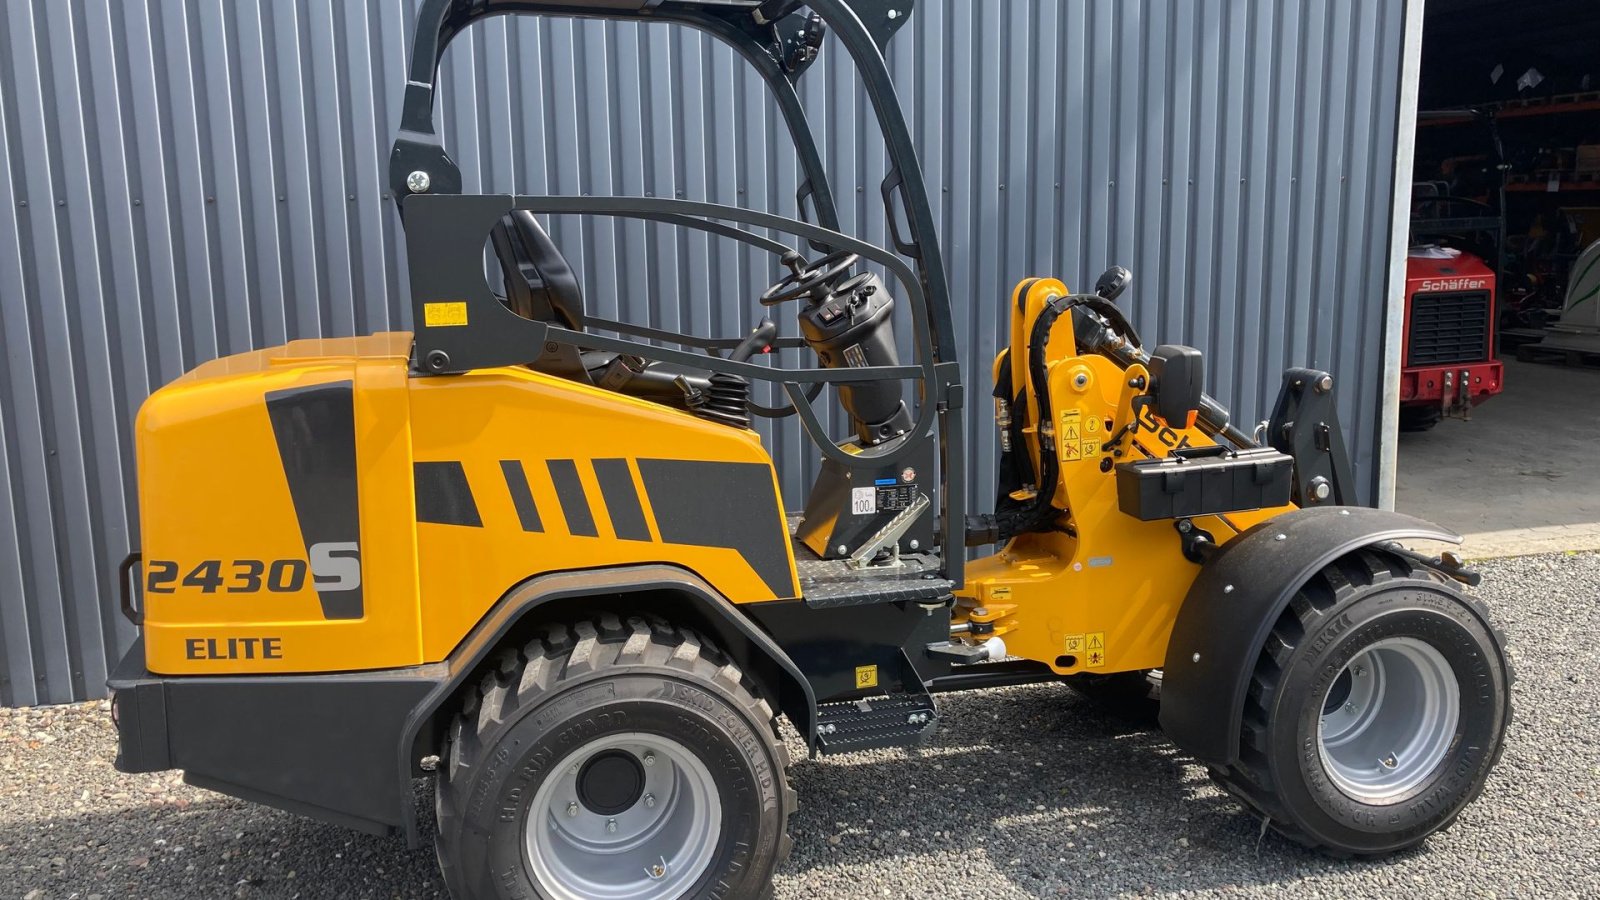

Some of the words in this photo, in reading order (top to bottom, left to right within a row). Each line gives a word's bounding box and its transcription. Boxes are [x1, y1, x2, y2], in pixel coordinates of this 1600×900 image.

[1418, 278, 1486, 292] Schäffer
[855, 500, 870, 512] 100
[1314, 618, 1344, 652] BKT
[185, 637, 283, 660] ELITE
[679, 687, 715, 712] SKID
[717, 706, 760, 760] POWER
